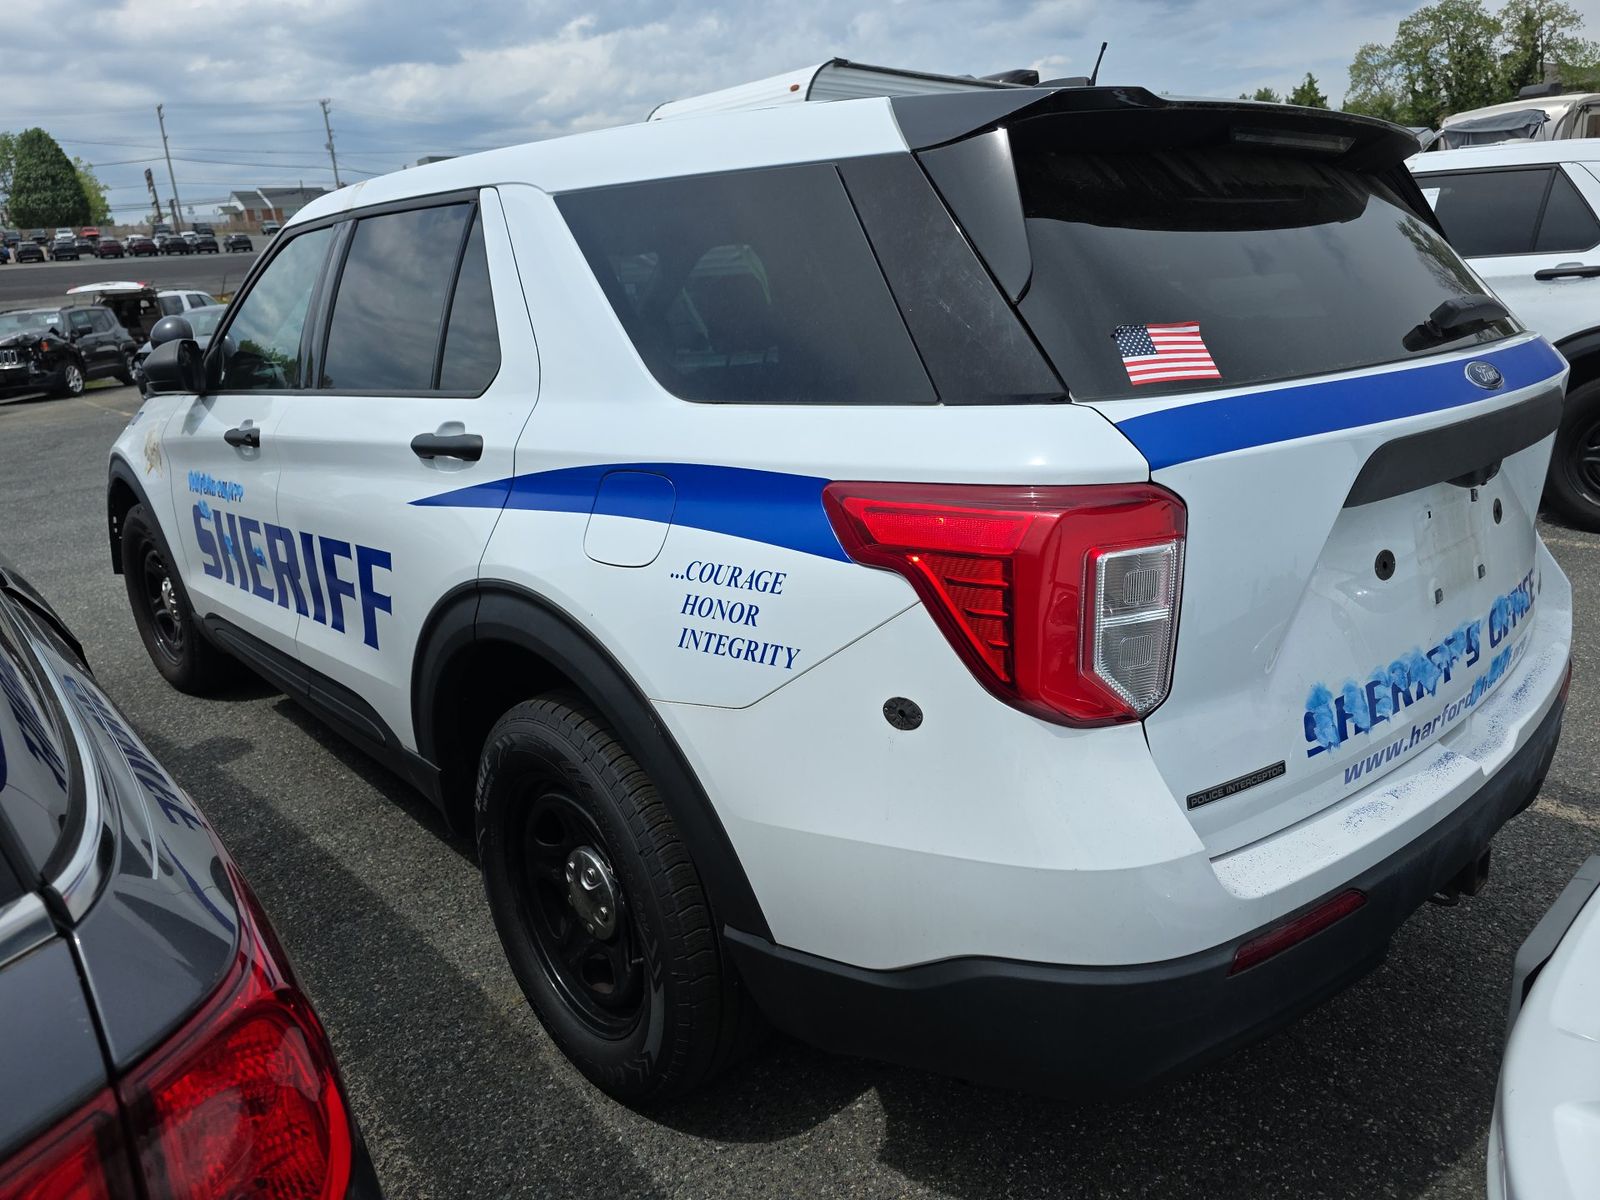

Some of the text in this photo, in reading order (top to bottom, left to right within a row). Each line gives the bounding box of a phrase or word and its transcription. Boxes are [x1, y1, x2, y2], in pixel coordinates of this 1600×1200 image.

[192, 502, 393, 651] SHERIFF
[680, 594, 760, 627] HONOR
[677, 627, 801, 670] INTEGRITY
[1190, 765, 1284, 808] POLICE INTERCEPTOR
